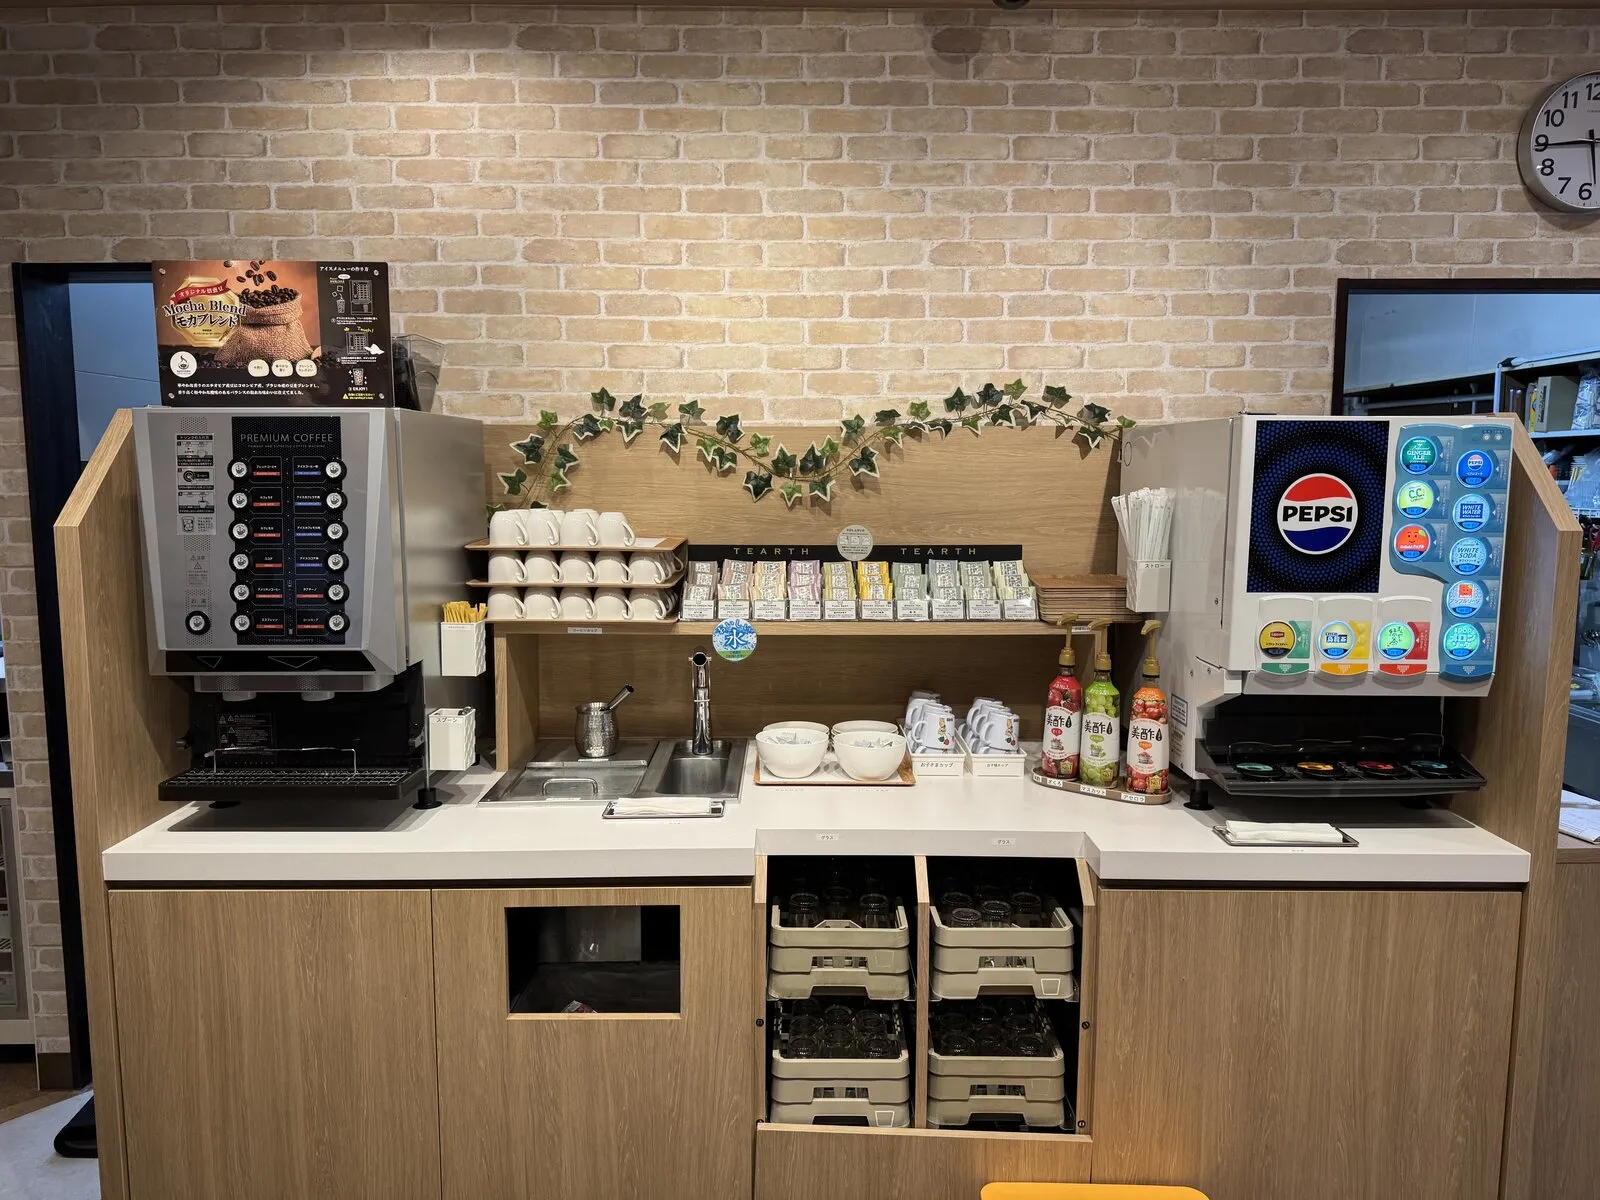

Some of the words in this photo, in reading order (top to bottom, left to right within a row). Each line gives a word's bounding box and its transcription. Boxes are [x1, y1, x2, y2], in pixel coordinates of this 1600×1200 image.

[1562, 91, 1578, 108] 11
[1586, 83, 1600, 101] 12
[1544, 109, 1565, 127] 10
[1534, 134, 1549, 152] 9
[1540, 158, 1555, 176] 8
[1558, 177, 1572, 194] 7
[1578, 182, 1593, 200] 6
[163, 300, 205, 316] Mocha
[209, 300, 247, 316] Blend
[176, 313, 238, 328] モカブレンド
[240, 433, 290, 442] PREMIUM
[293, 433, 333, 442] COFFEE
[1282, 505, 1353, 523] PEPSI
[733, 547, 810, 555] TEARTH
[900, 547, 977, 555] TEARTH
[725, 628, 748, 649] 水
[1046, 713, 1065, 727] 美酢
[1085, 719, 1106, 734] 美酢
[1131, 725, 1155, 740] 美酢
[1081, 786, 1105, 795] マスカット
